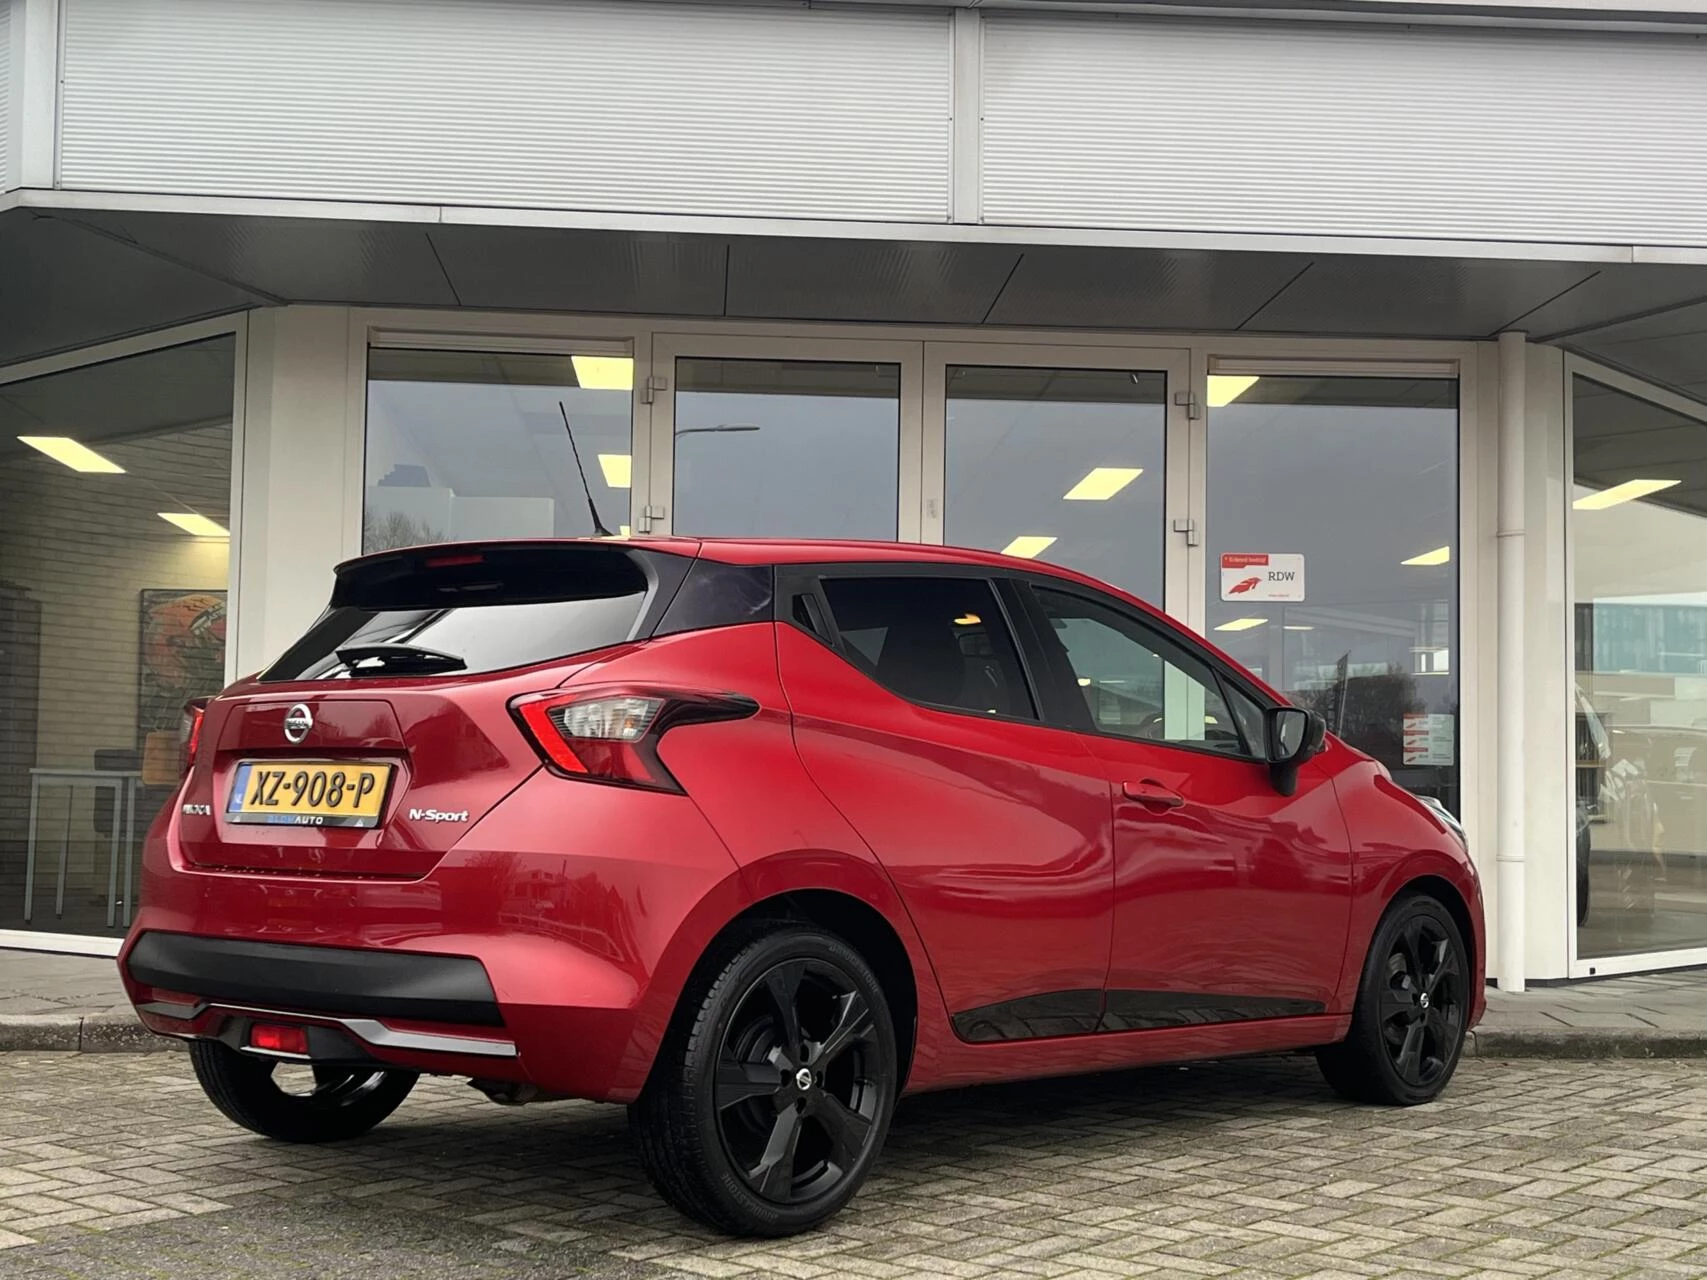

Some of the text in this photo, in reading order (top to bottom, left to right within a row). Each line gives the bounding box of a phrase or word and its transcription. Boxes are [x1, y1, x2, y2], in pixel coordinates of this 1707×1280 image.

[1268, 571, 1295, 581] RDW
[250, 771, 375, 808] XZ-908-P
[409, 808, 469, 824] N-Sport
